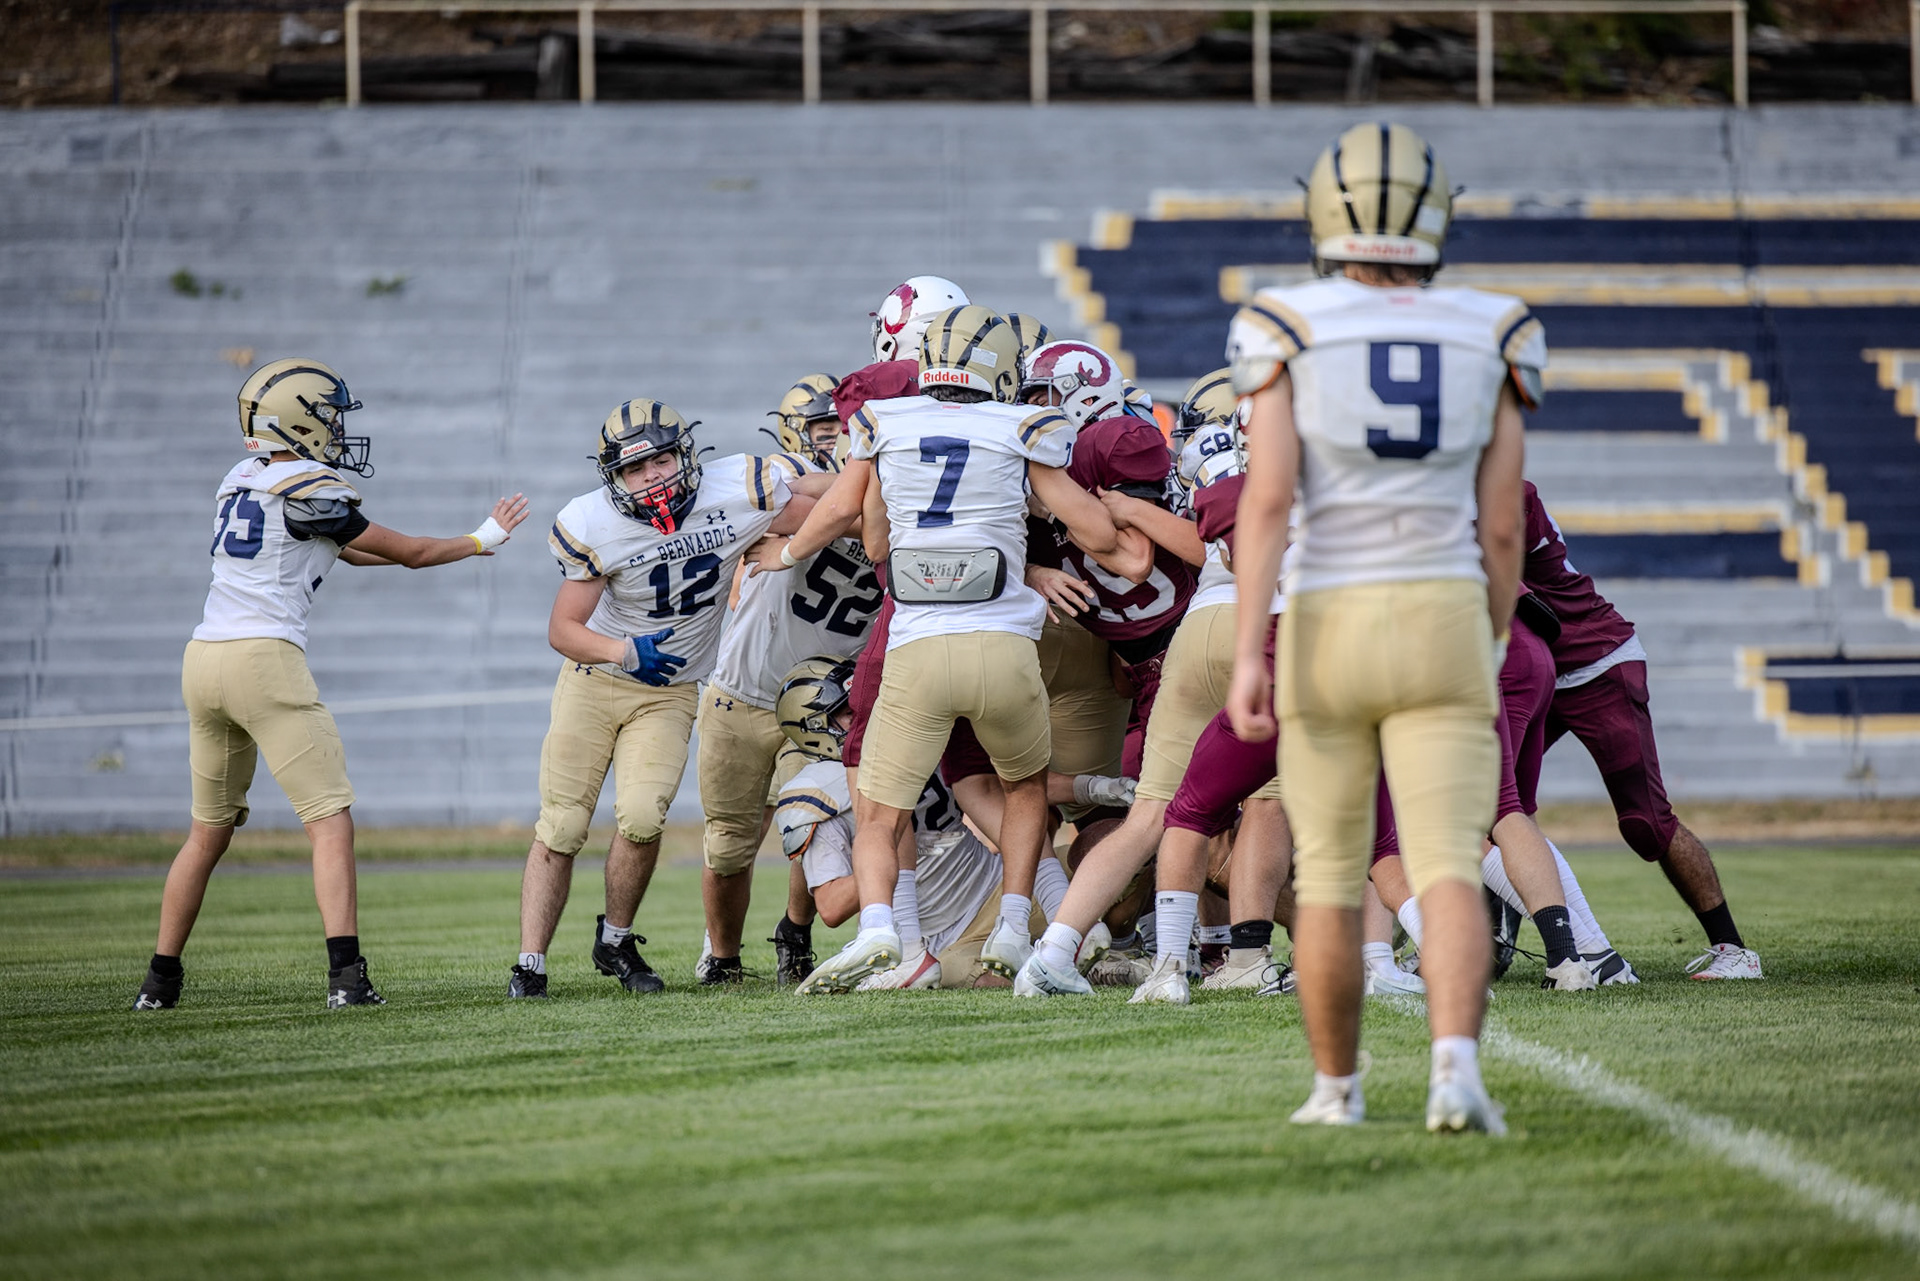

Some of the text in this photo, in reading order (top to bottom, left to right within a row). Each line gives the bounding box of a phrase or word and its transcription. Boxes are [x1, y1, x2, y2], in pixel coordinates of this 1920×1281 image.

[923, 372, 970, 385] Riddell
[1367, 342, 1440, 460] 9
[622, 442, 649, 456] Riddell
[917, 435, 970, 529] 7
[657, 524, 737, 561] BERNARD'S
[647, 552, 724, 619] 12
[790, 546, 885, 638] 52
